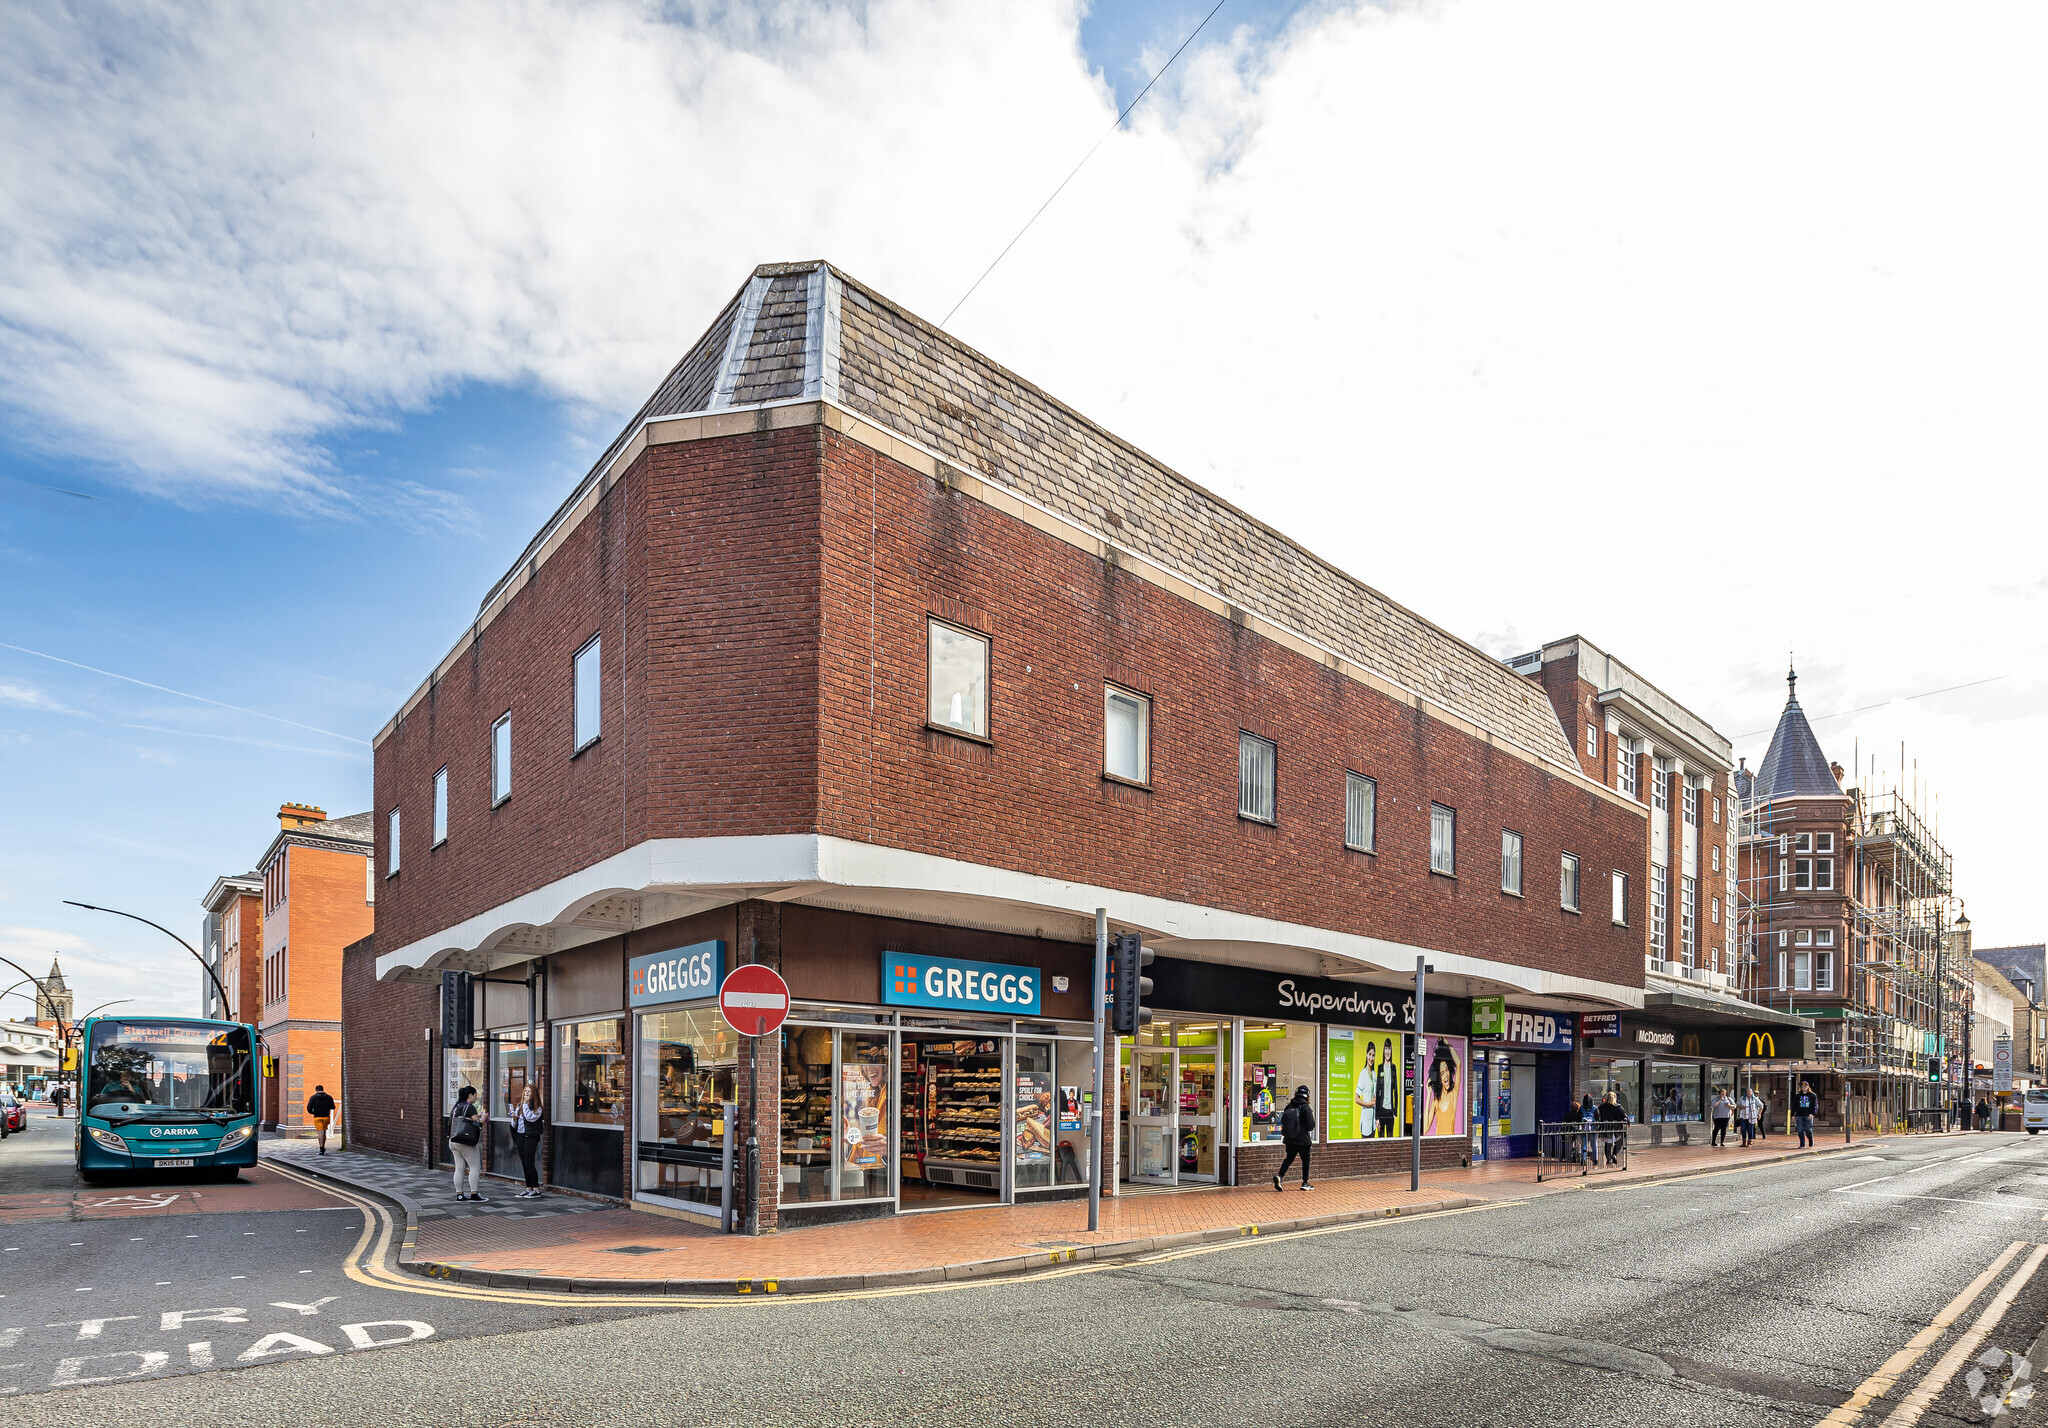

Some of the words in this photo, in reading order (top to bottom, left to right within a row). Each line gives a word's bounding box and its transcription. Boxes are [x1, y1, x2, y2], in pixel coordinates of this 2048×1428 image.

[647, 952, 712, 994] GREGGS
[924, 966, 1034, 1005] GREGGS
[1278, 979, 1396, 1025] Superdrug
[1583, 1014, 1617, 1022] BETFRED
[124, 1026, 170, 1037] Stockwell
[1504, 1012, 1556, 1044] TFRED
[1559, 1027, 1572, 1035] bonus
[206, 1030, 228, 1046] 42
[1562, 1036, 1572, 1046] king
[1638, 1030, 1675, 1045] McDonald's
[846, 1082, 857, 1090] FOR
[846, 1090, 858, 1098] LIKE
[859, 1090, 876, 1098] THESE
[163, 1128, 199, 1136] ARRIVA
